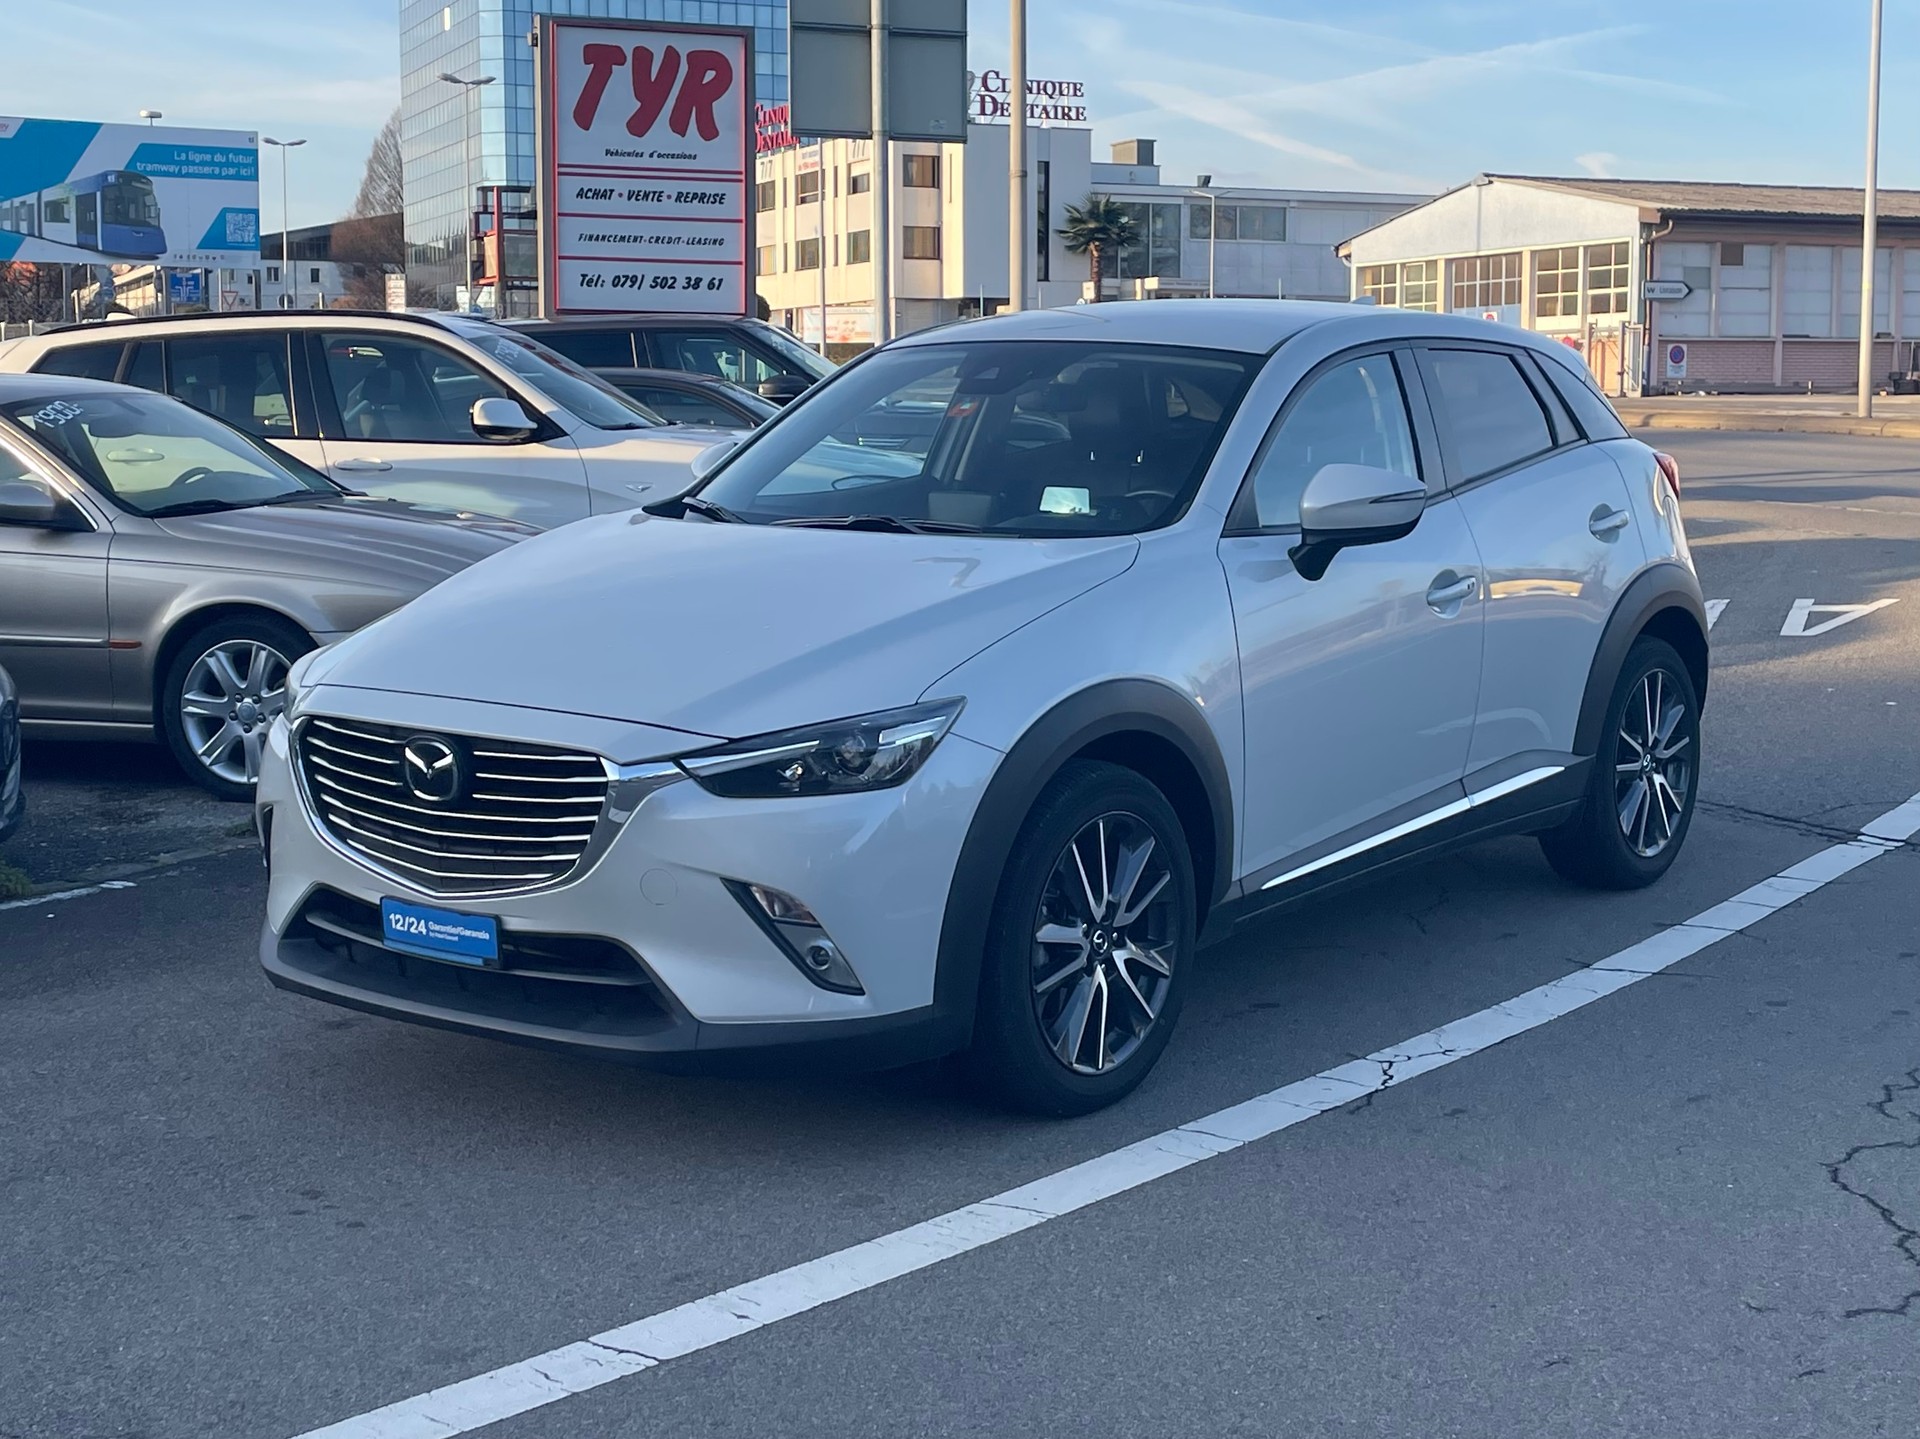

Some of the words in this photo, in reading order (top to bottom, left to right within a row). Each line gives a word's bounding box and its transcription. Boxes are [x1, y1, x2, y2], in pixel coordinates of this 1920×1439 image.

[573, 43, 733, 141] TYR
[981, 70, 1084, 99] CLNIQUE
[977, 94, 1086, 121] DETAIRE
[174, 150, 186, 160] La
[188, 151, 211, 162] ligne
[214, 152, 226, 162] du
[228, 153, 254, 164] futur
[605, 148, 644, 158] Véhicules
[649, 151, 697, 160] d'occasions
[136, 162, 180, 174] tramway
[181, 165, 219, 175] passera
[221, 167, 237, 176] par
[576, 187, 615, 201] ACHAT
[626, 189, 665, 203] VENTE
[674, 191, 727, 205] REPRISE
[579, 273, 606, 288] Tél:
[649, 276, 677, 290] 502
[682, 277, 702, 290] 38
[707, 278, 724, 291] 61
[389, 912, 427, 935] 12/24
